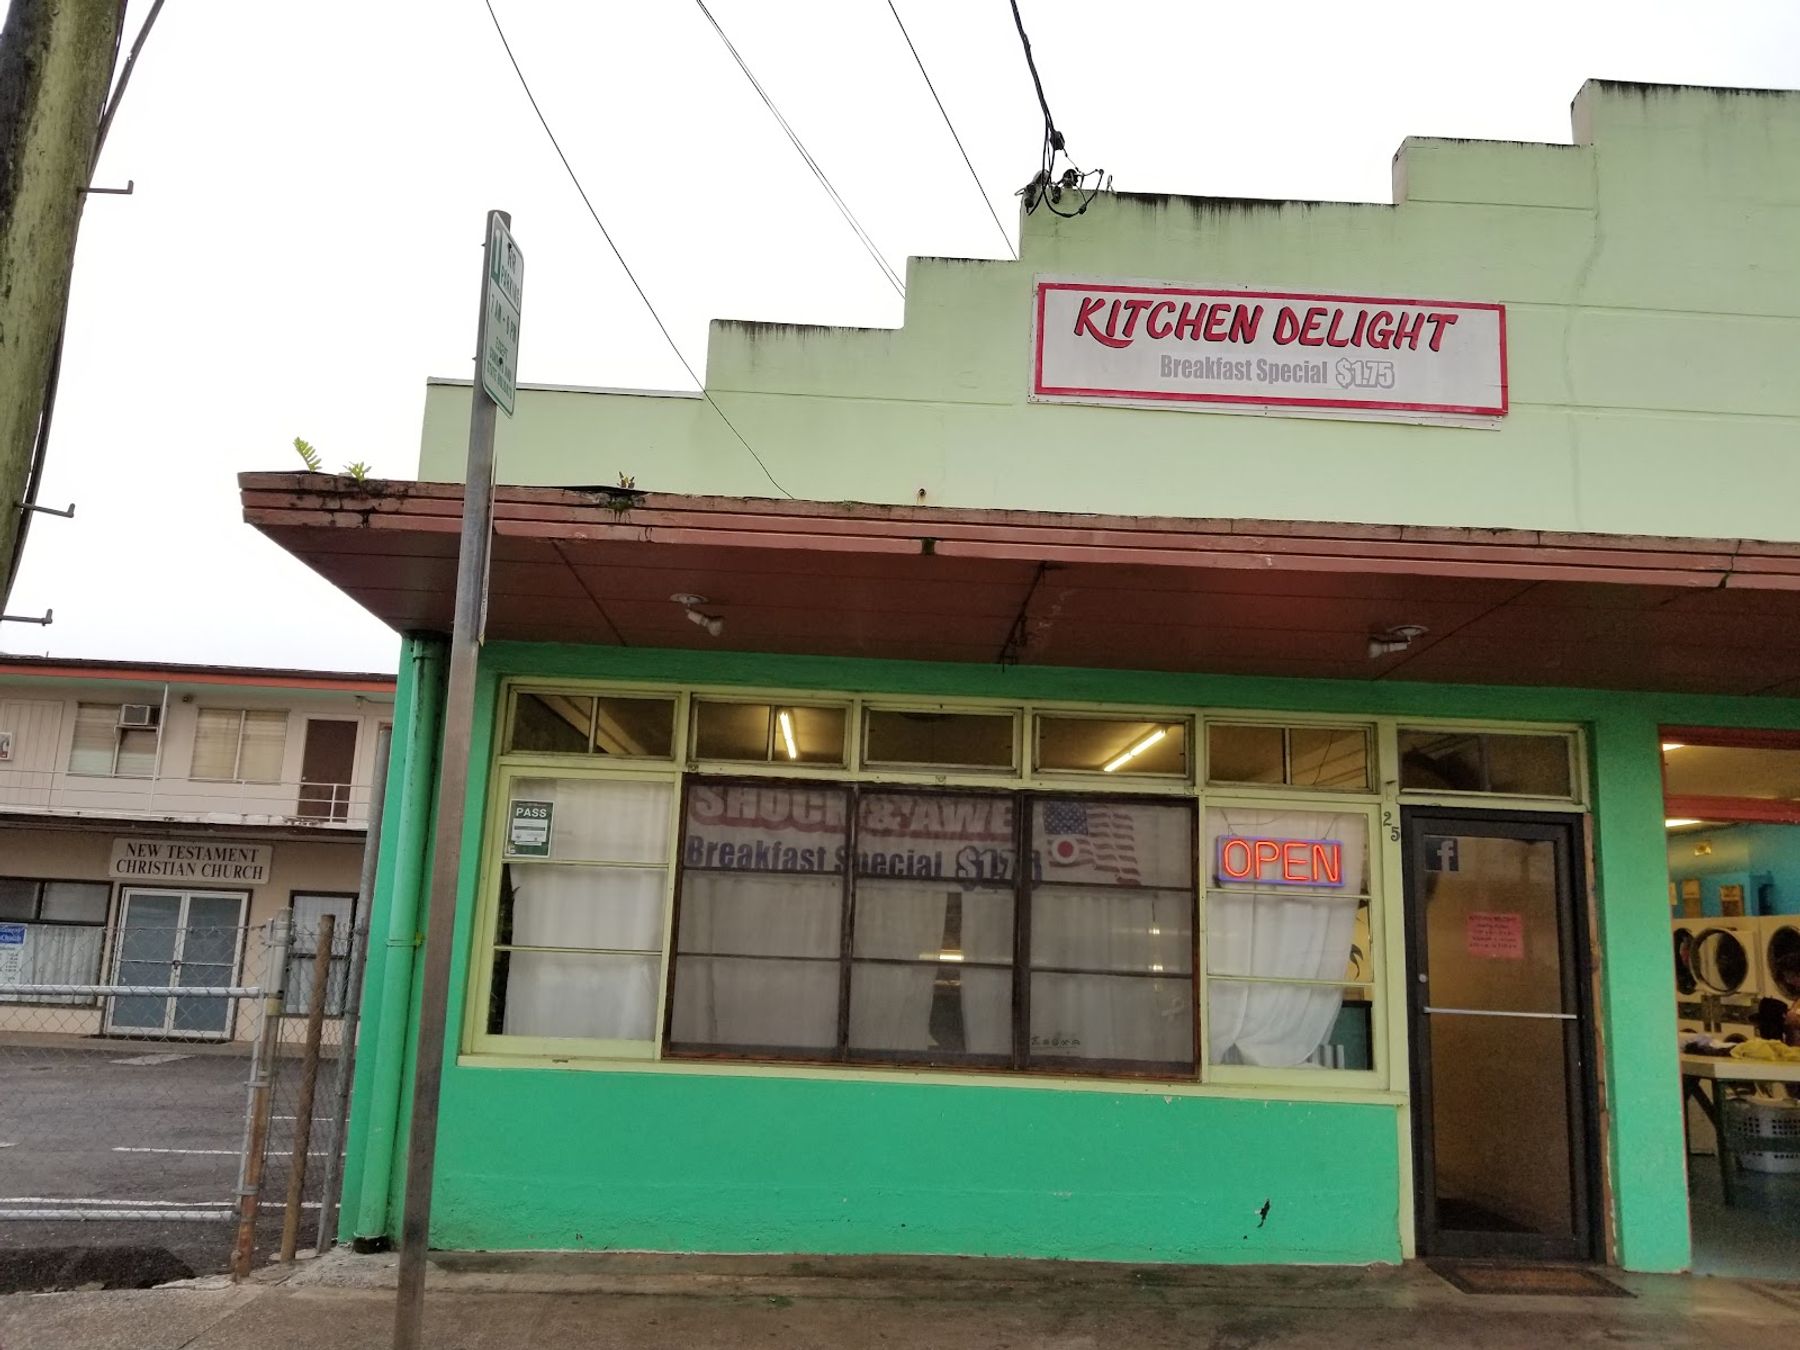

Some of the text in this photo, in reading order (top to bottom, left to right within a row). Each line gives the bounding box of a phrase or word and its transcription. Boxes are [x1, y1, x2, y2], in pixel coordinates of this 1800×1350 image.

[1074, 296, 1459, 352] KITCHEN DELIGHT
[1160, 354, 1395, 389] Breakfast Special $1.75
[516, 808, 547, 818] PASS
[908, 799, 1013, 838] AWE
[116, 859, 265, 880] CHRISTIAN CHURCH
[126, 843, 260, 863] NEW TESTAMENT
[686, 835, 827, 871] Breakfast
[1223, 839, 1342, 883] OPEN
